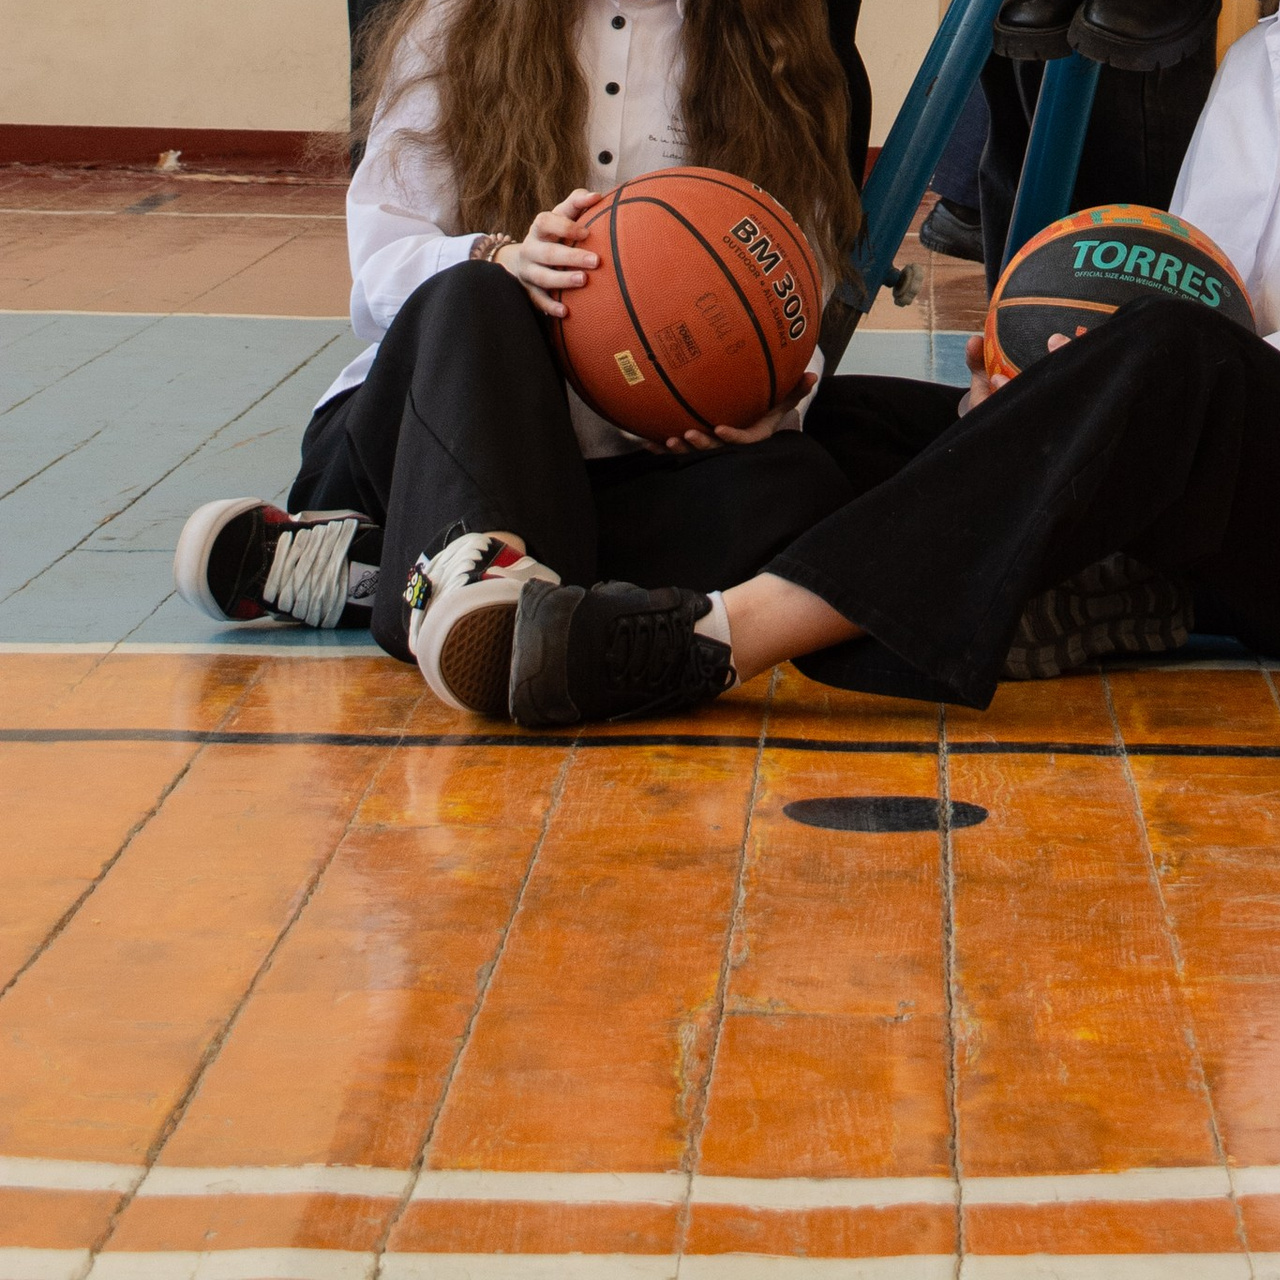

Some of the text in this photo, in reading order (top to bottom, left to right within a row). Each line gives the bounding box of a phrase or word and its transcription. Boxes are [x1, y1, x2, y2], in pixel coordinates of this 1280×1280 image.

[722, 235, 788, 349] OUTDOOR ALL SURFACE
[729, 216, 783, 276] BM
[772, 271, 807, 340] 300
[1072, 240, 1223, 307] TORRES
[1104, 272, 1119, 280] SIZE
[1119, 274, 1135, 282] AND
[1135, 277, 1161, 290] WEIGHT
[1162, 285, 1178, 296] NO.7
[677, 323, 700, 358] TORRES
